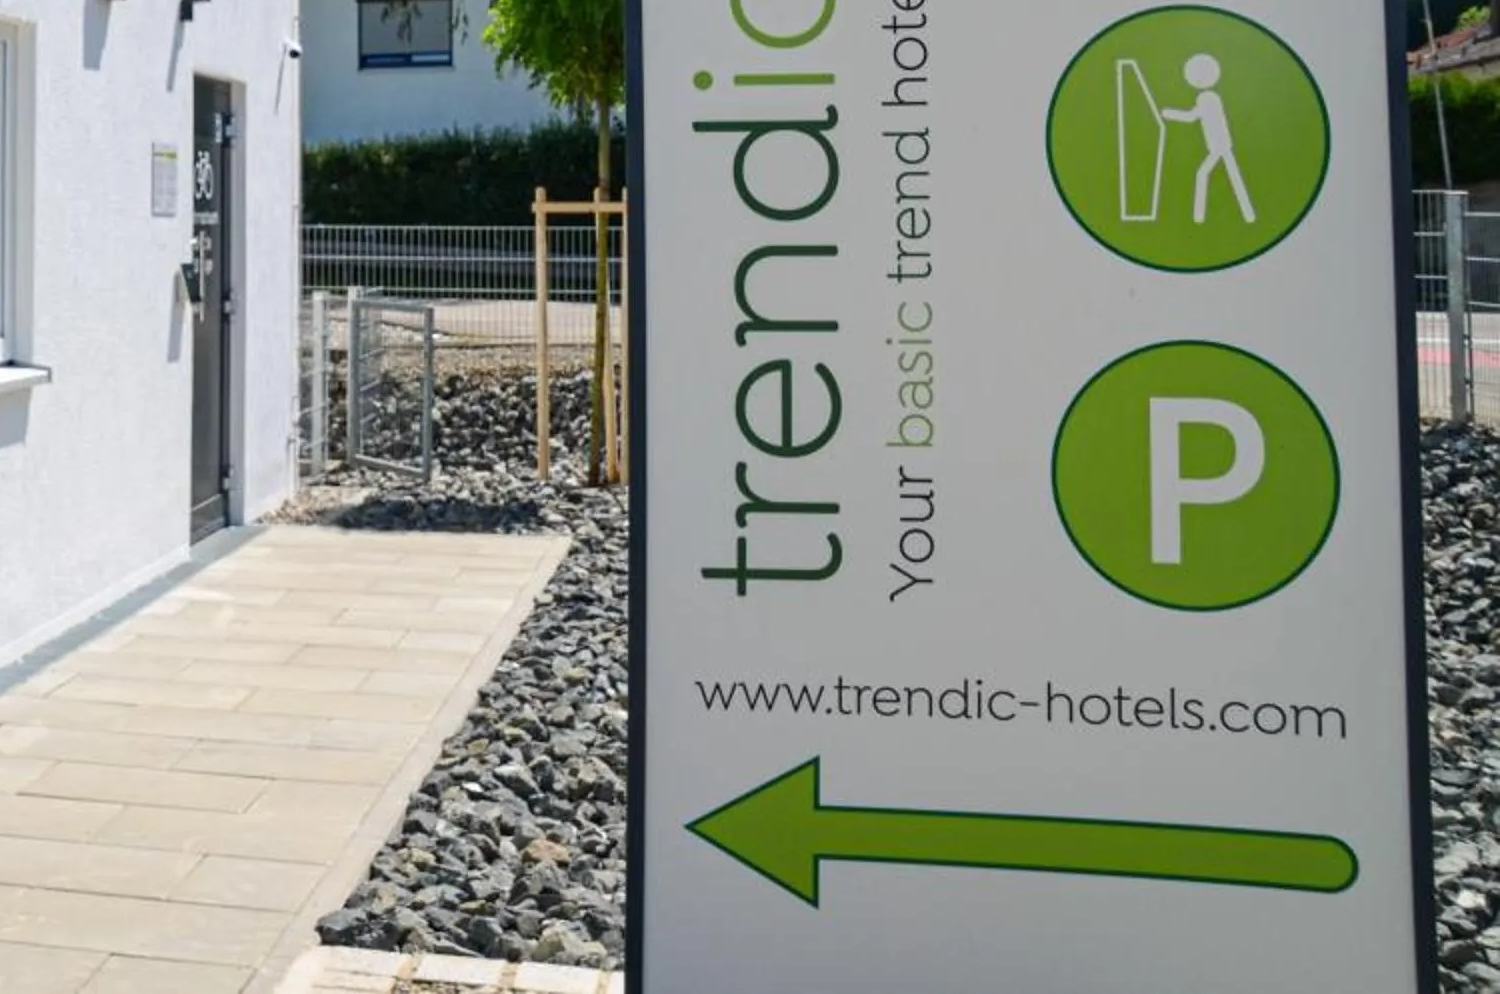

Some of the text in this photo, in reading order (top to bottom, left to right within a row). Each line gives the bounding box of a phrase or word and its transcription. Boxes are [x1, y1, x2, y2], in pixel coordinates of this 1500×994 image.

[881, 129, 932, 284] trend
[885, 301, 935, 448] basic
[889, 466, 935, 602] Your
[1149, 397, 1266, 566] P
[695, 675, 1348, 739] www.trendic-hotels.com
